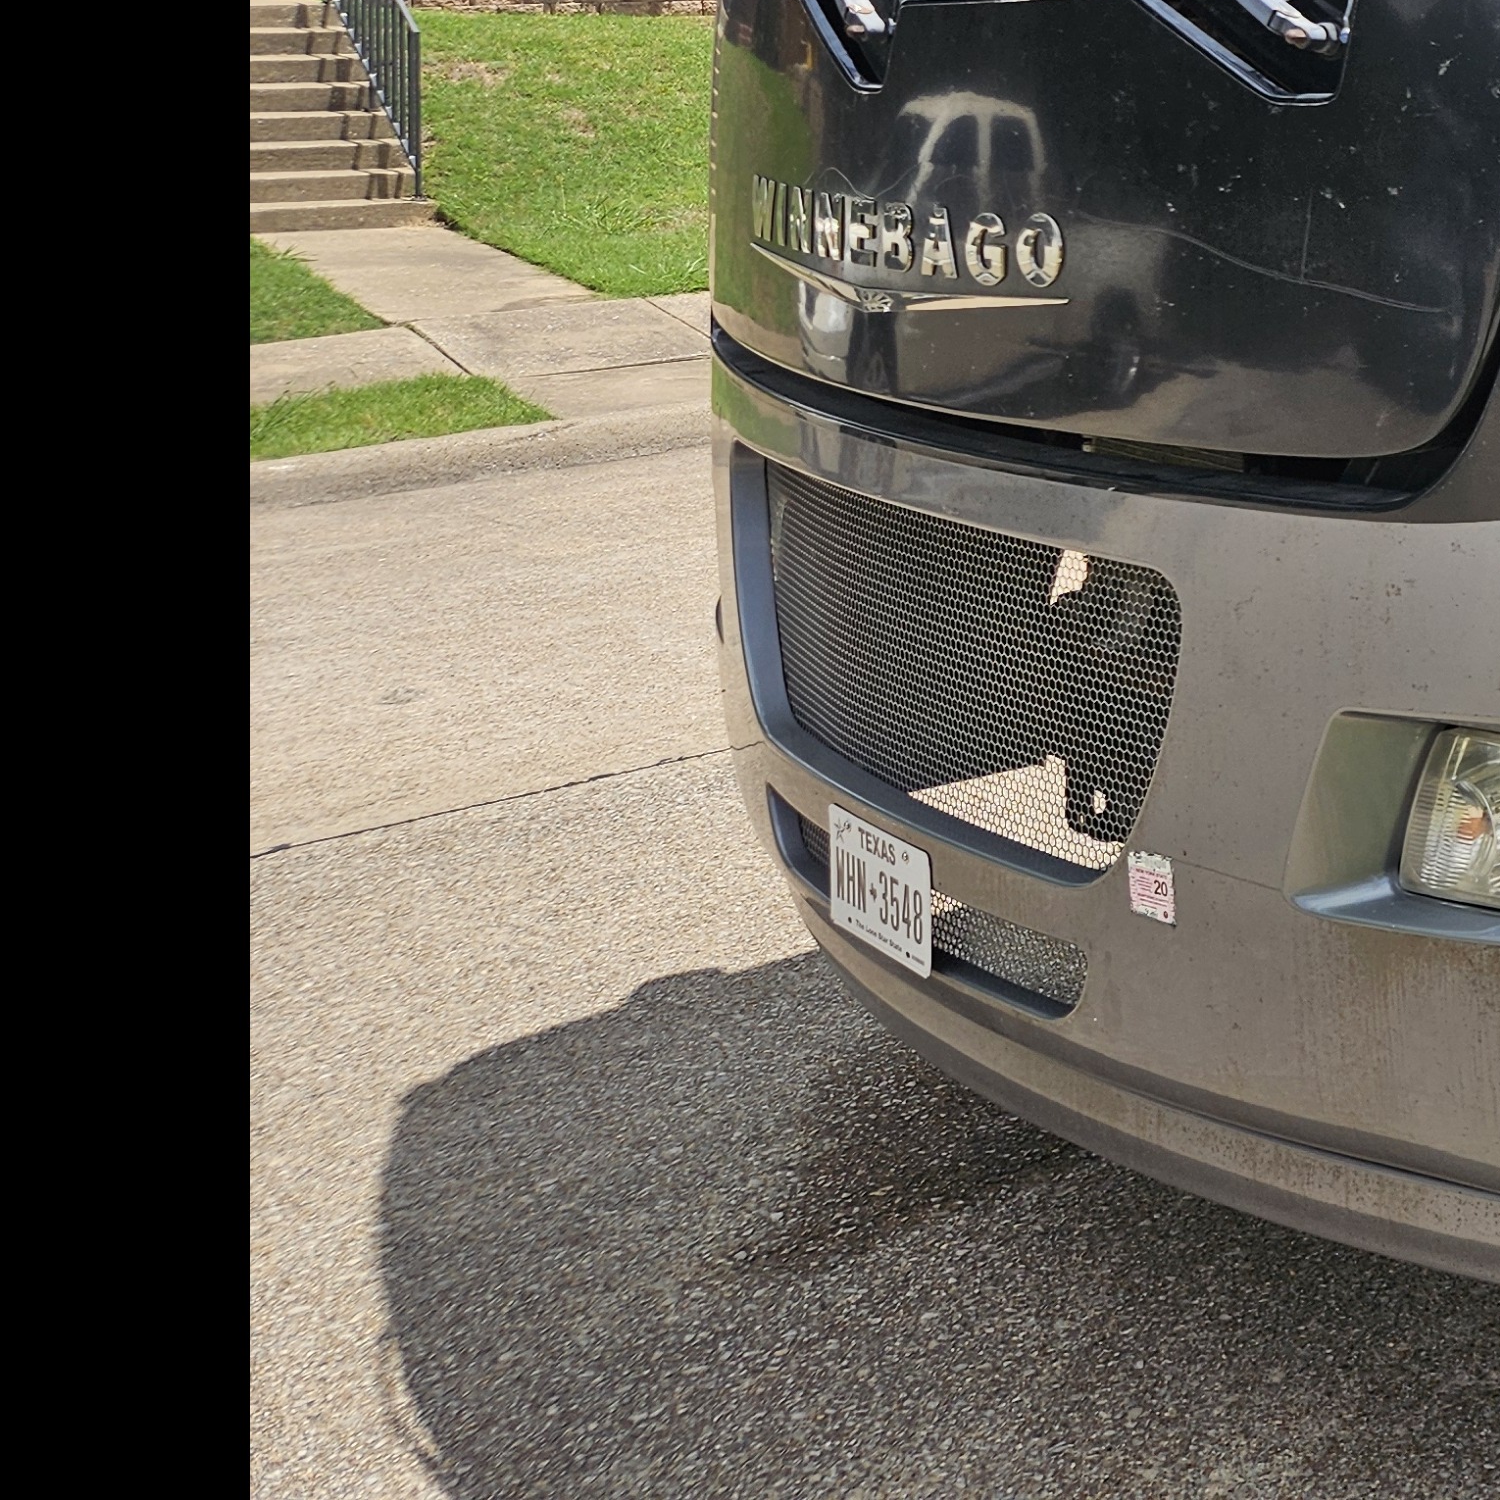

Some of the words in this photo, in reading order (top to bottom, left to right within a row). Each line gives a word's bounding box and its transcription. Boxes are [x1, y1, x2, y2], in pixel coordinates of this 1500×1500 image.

[752, 173, 1065, 288] WINNEBAGO
[858, 826, 896, 866] TEXAS
[836, 846, 867, 914] WHN
[879, 870, 923, 945] 3548
[1153, 880, 1168, 897] 20
